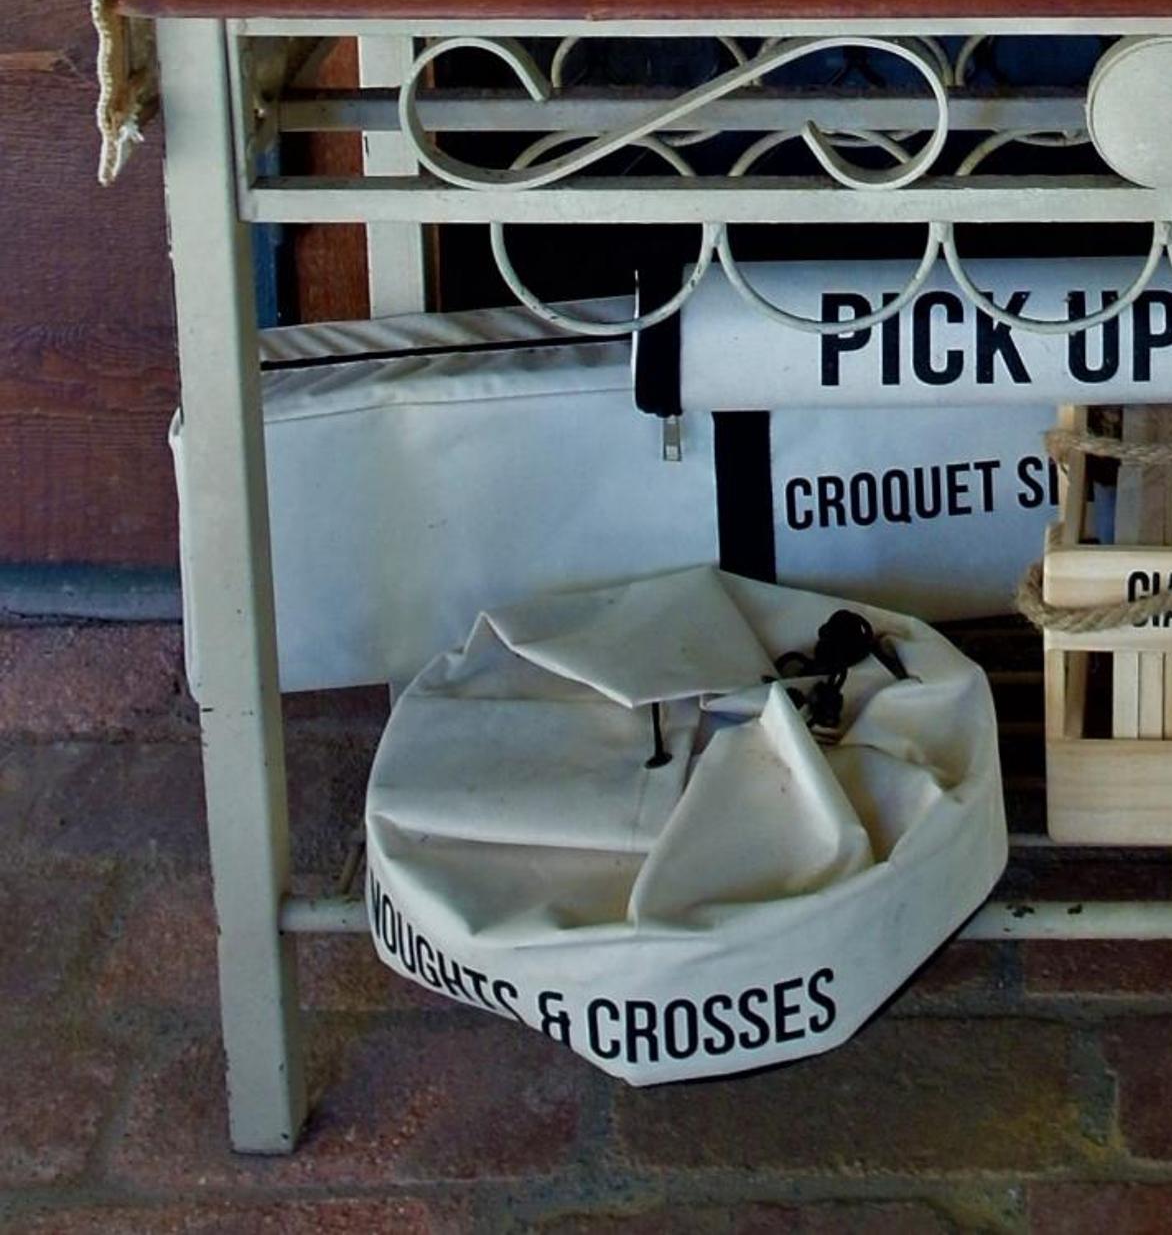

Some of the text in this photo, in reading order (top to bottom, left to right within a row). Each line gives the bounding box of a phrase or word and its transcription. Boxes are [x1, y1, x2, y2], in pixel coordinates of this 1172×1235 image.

[820, 291, 1032, 387] PICK
[785, 460, 1000, 532] CROQUET
[369, 868, 836, 1064] NOUGHTS & CROSSES
